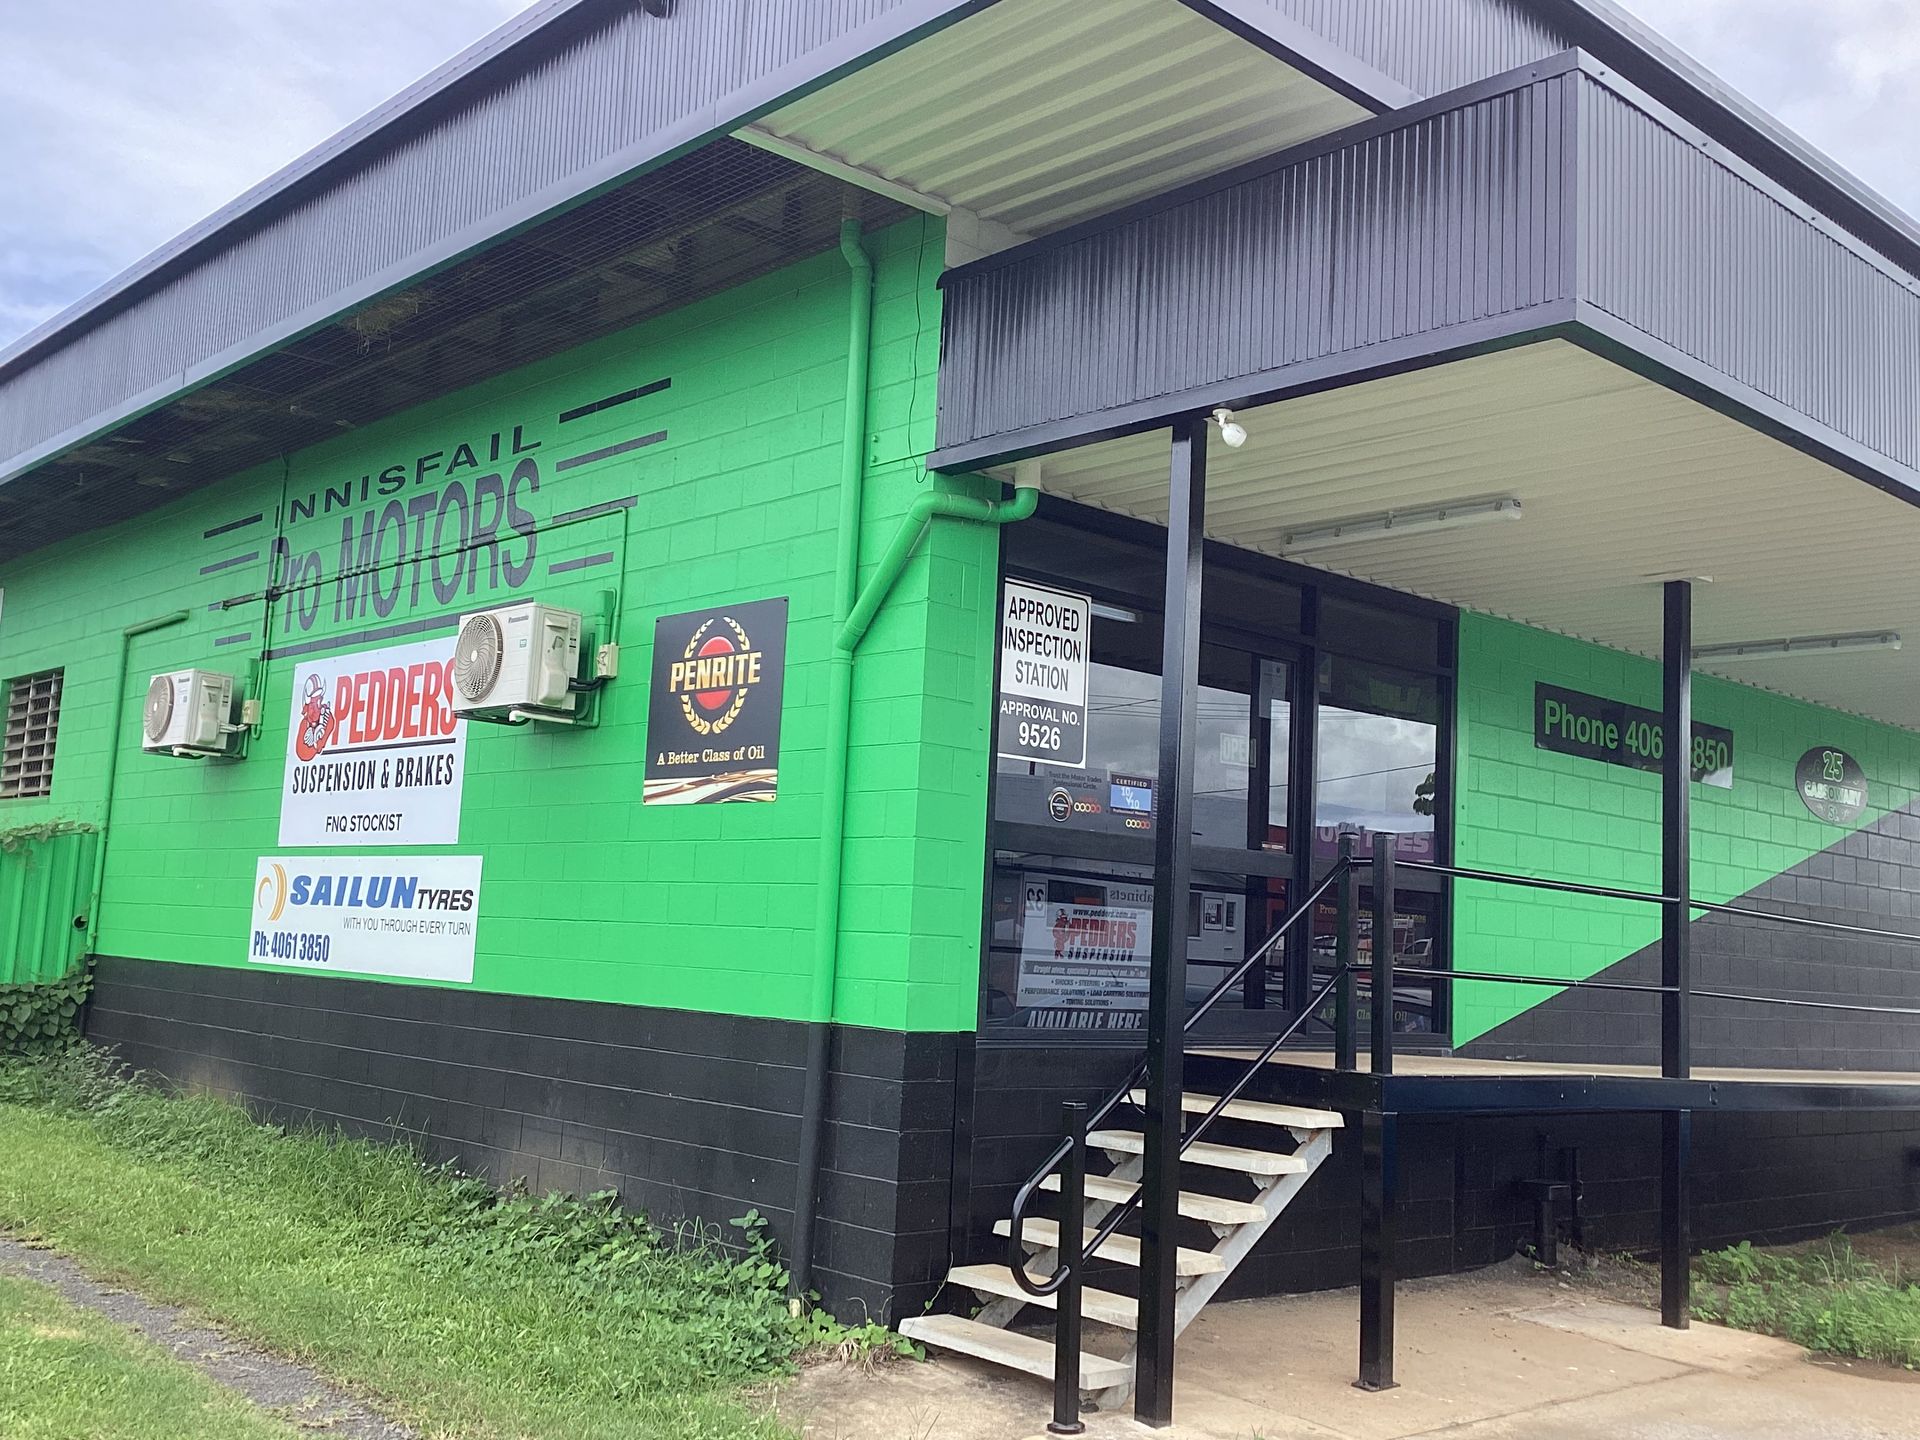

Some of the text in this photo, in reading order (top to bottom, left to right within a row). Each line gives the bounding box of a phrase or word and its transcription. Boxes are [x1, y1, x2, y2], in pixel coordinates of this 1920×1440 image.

[333, 457, 541, 624] MOTORS
[1008, 596, 1079, 632] APPROVED
[1005, 626, 1081, 663] INSPECTION
[670, 652, 762, 693] PENRITE
[1015, 659, 1068, 691] STATION
[331, 657, 457, 745] PEDDERS
[1000, 700, 1081, 726] APPROVAL NO.
[1018, 722, 1061, 750] 9526
[1545, 700, 1728, 772] Phone 406 850
[656, 745, 765, 765] A Better Class of Oil
[1823, 750, 1844, 782] 25
[292, 753, 455, 794] SUSPENSION & BRAKES
[1116, 778, 1148, 787] CERTIFIED
[325, 813, 402, 833] FNQ STOCKIST
[290, 875, 474, 912] SAILUN TYRES
[343, 917, 471, 936] WITH YOU THROUGH EVERY TURN
[1070, 917, 1138, 949] PEDDERS
[253, 930, 331, 962] Ph: 4061 3850
[1068, 947, 1134, 962] SUSPENSION
